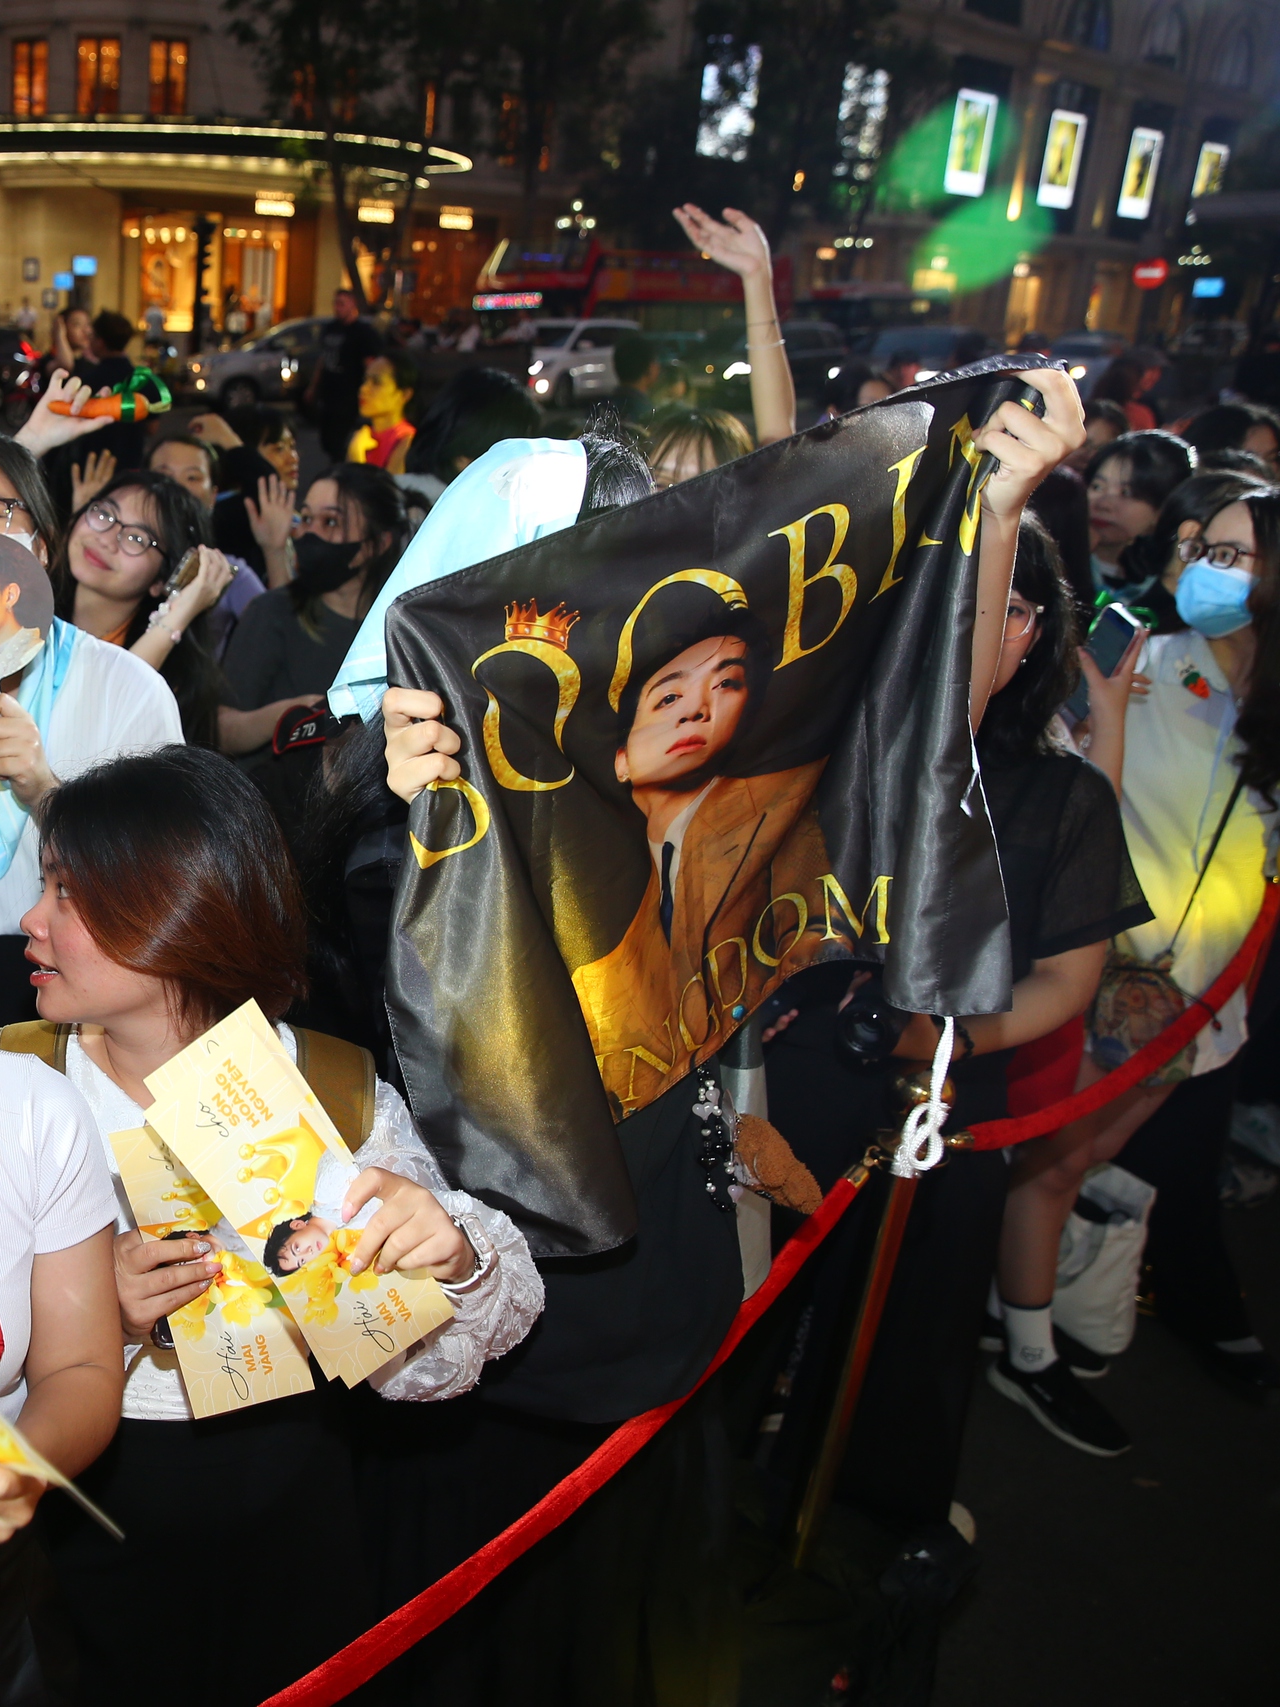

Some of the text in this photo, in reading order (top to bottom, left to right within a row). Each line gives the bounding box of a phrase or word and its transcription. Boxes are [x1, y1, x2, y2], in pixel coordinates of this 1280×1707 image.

[196, 1101, 229, 1138] cho
[376, 1301, 396, 1327] MAI
[386, 1288, 412, 1322] VÀNG
[241, 1344, 256, 1372] MAI
[255, 1334, 273, 1375] VÀNG
